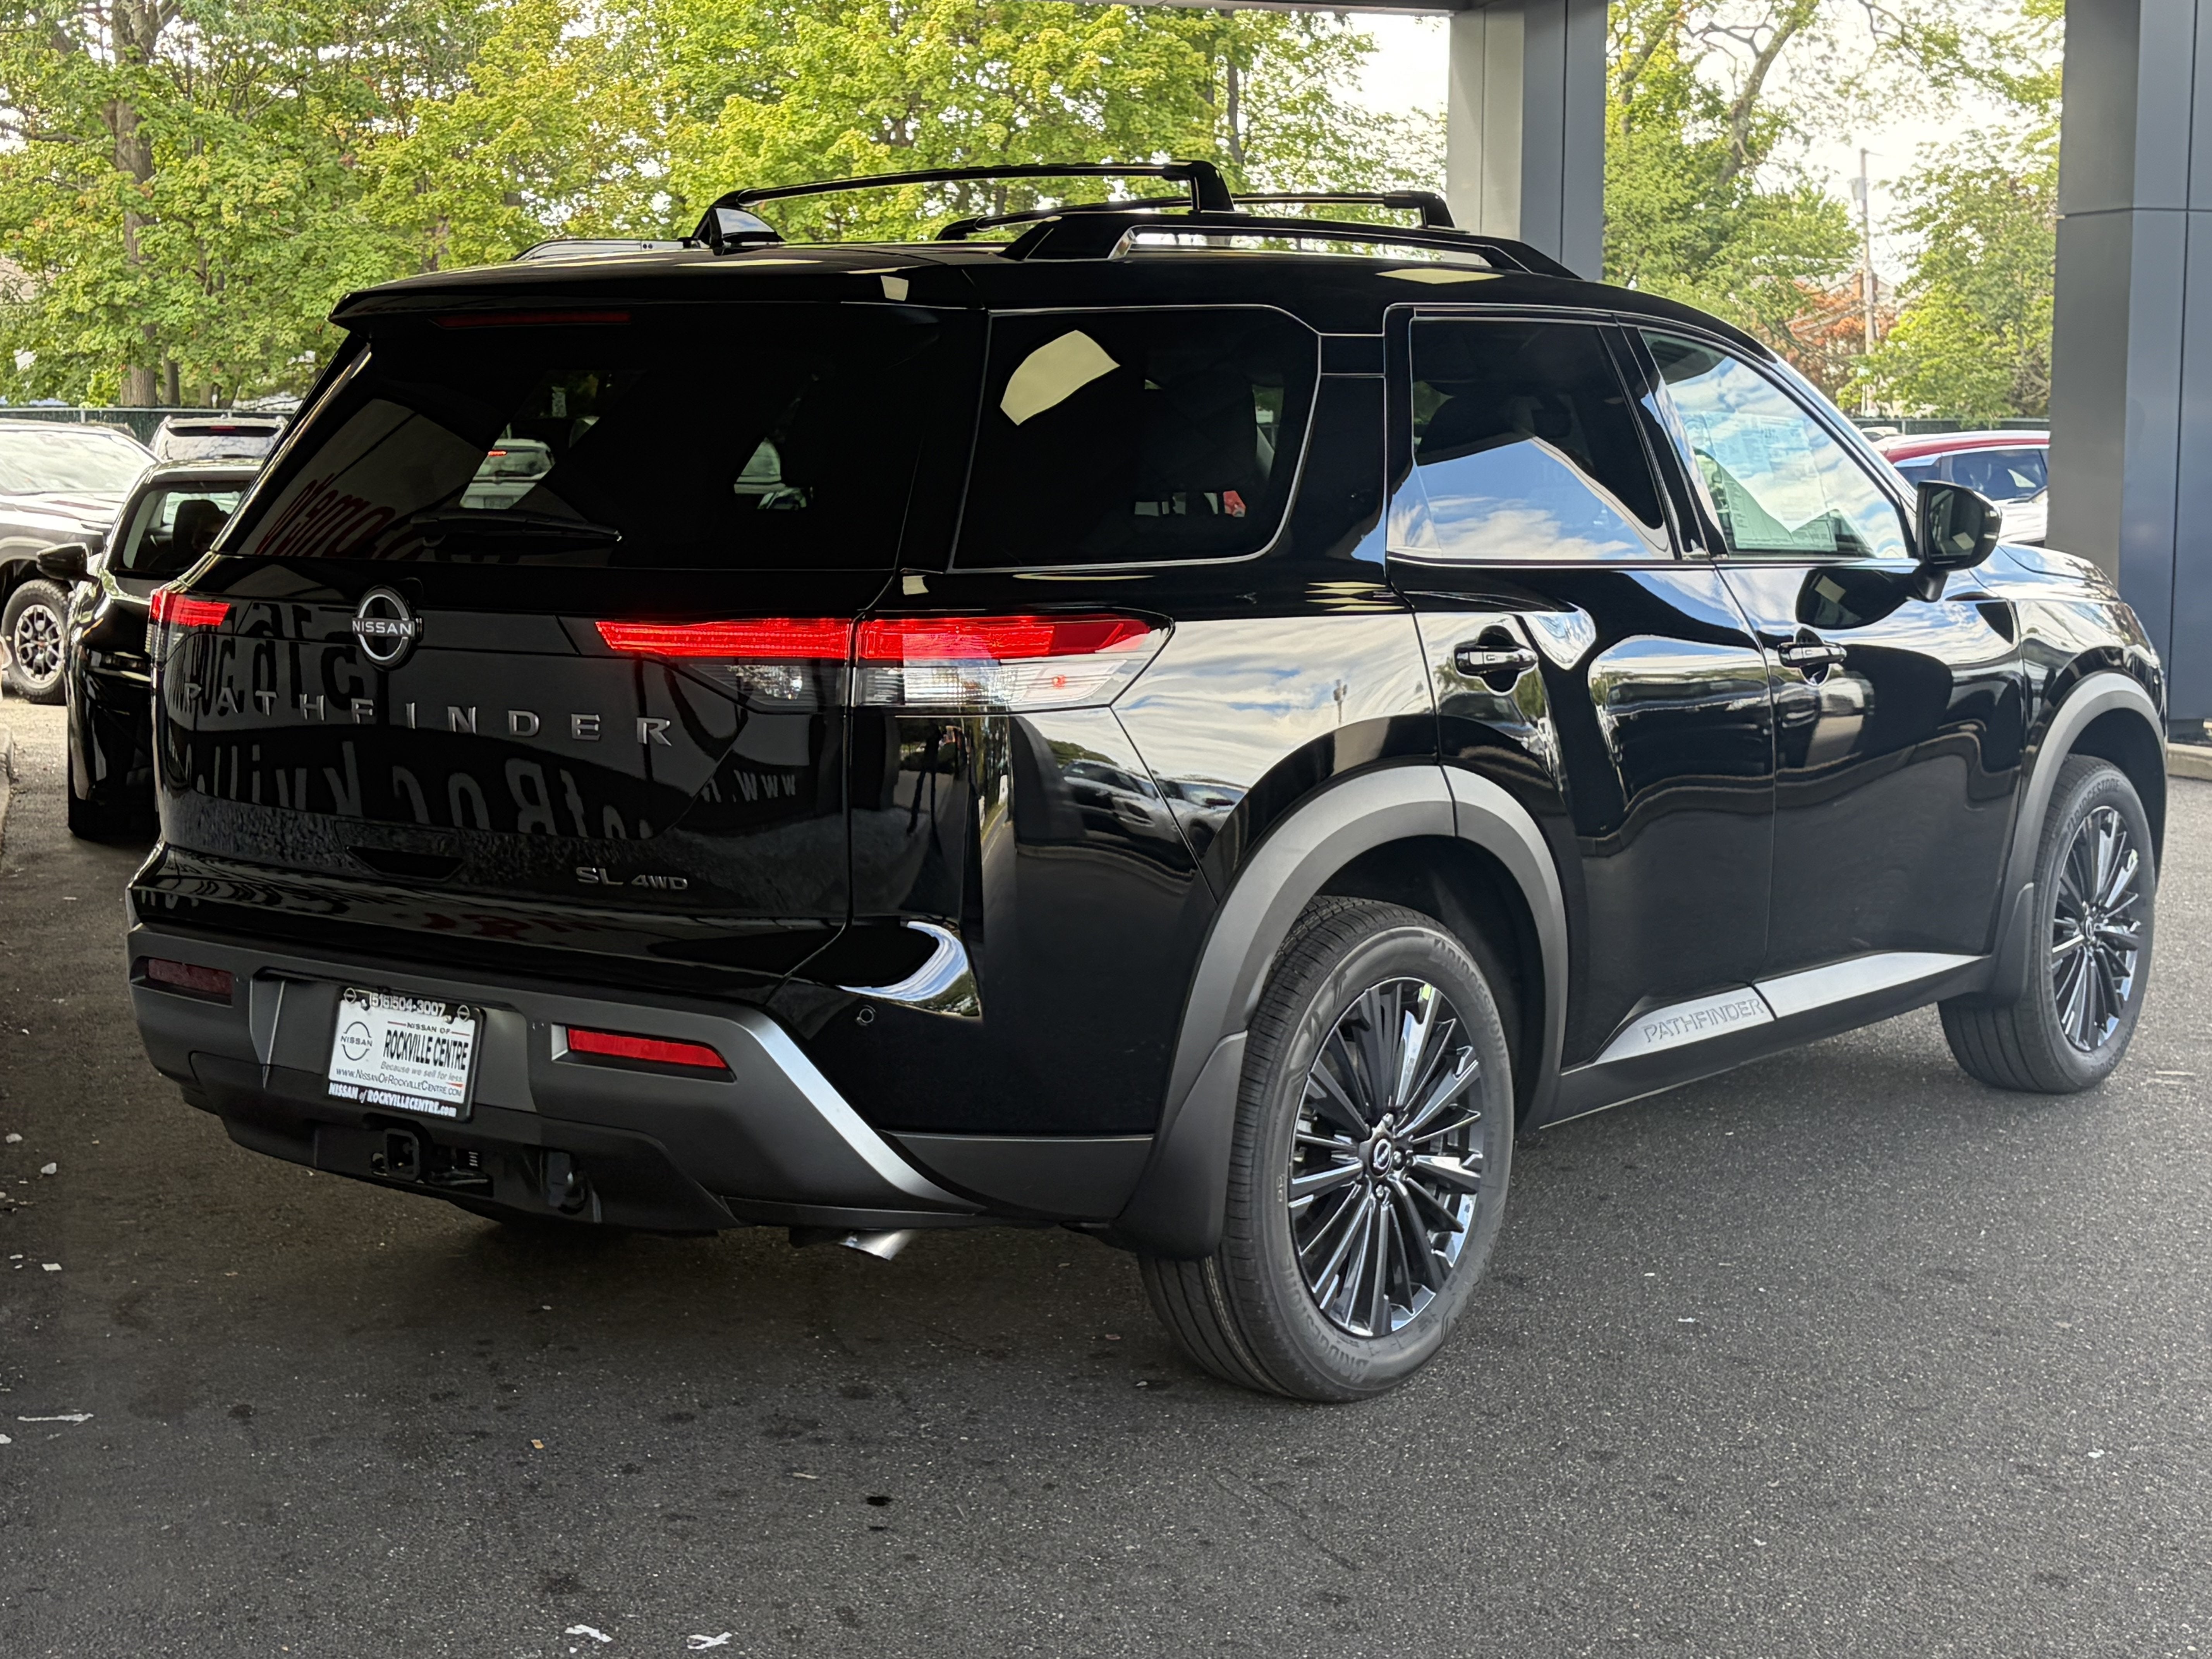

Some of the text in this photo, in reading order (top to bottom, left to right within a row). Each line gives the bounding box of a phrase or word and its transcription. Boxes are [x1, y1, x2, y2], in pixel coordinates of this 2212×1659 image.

[352, 620, 411, 635] NISSAN
[184, 682, 673, 747] PATHFINDER
[576, 867, 688, 890] SL 4WD
[407, 1022, 437, 1032] NISSAN
[1642, 998, 1764, 1042] PATHFINDER
[340, 1035, 373, 1047] NISSAN
[383, 1029, 469, 1070] ROCKVILLE CENTRE
[380, 1060, 410, 1074] Because
[412, 1068, 422, 1076] we
[423, 1069, 436, 1078] sell
[328, 1082, 457, 1118] NISSAN of ROCKVILLECENTRE.com
